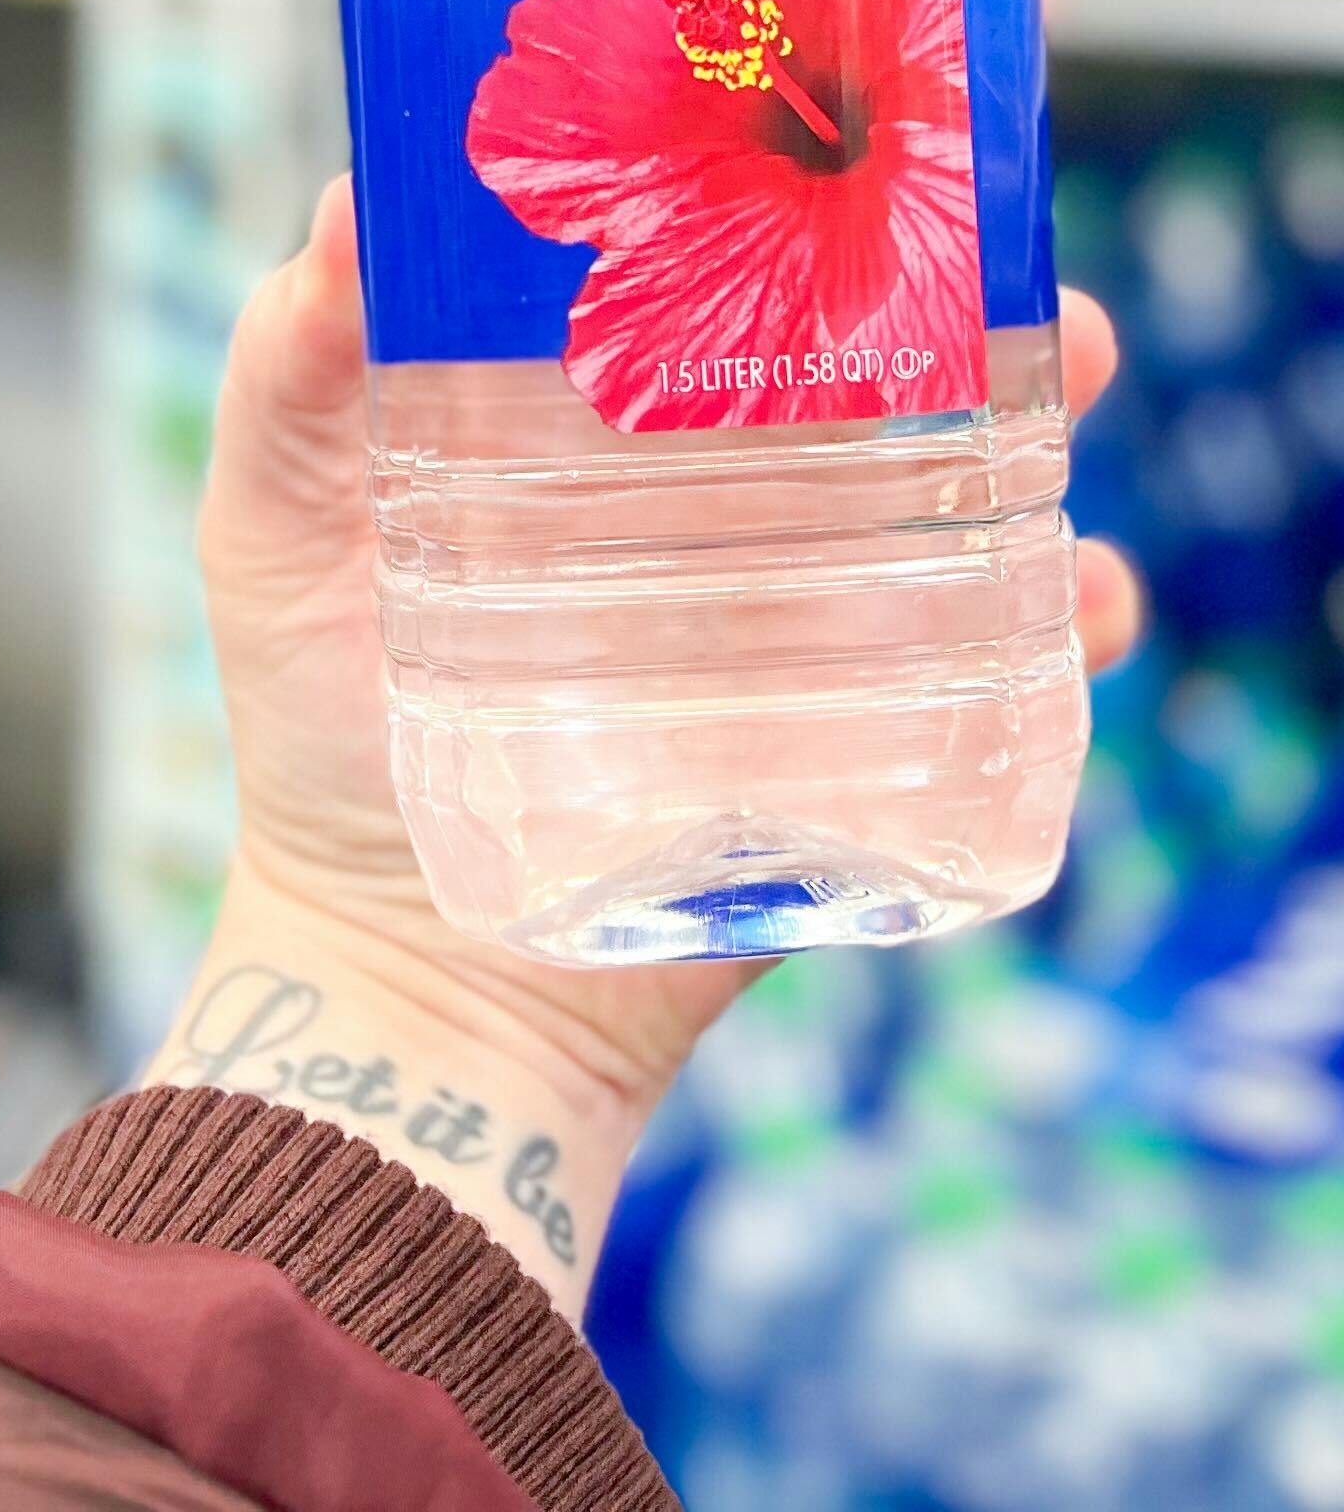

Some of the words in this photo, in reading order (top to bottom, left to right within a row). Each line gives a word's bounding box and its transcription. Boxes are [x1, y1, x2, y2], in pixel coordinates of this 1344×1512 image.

[657, 360, 695, 393] 1.5
[701, 356, 767, 391] LITER
[772, 351, 836, 389] (1.58
[842, 348, 885, 383] QT)
[404, 1087, 491, 1164] it
[504, 1134, 576, 1267] be
